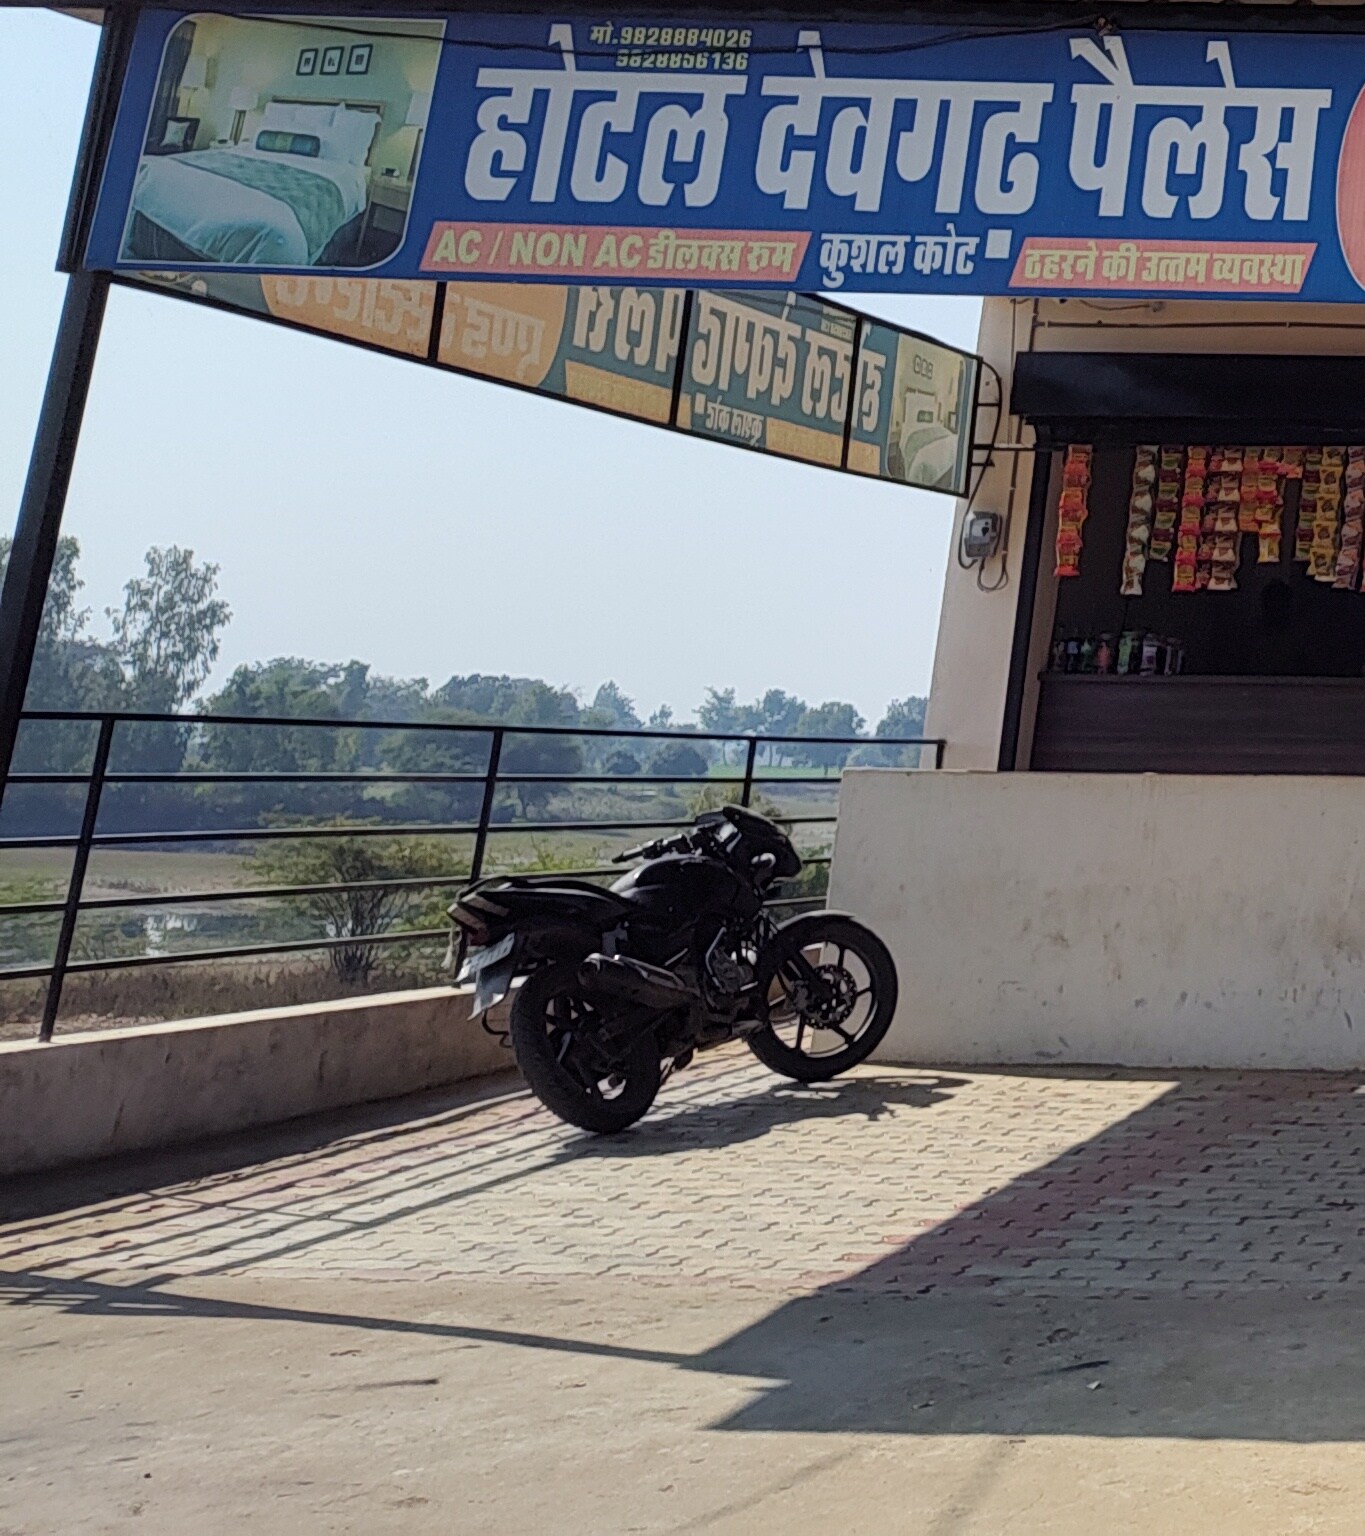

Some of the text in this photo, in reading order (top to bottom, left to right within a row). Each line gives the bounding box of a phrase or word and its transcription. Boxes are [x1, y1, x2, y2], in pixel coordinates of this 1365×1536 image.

[590, 21, 752, 49] मो.9828884026
[464, 23, 749, 208] होटल
[1068, 36, 1333, 222] पैलेस
[432, 229, 482, 264] AC
[509, 231, 587, 266] NON
[589, 234, 642, 267] AC
[819, 222, 980, 289] कुशल कोट
[1024, 241, 1098, 281] ठहरने
[1101, 243, 1140, 283] की
[1212, 253, 1305, 286] व्यवस्था
